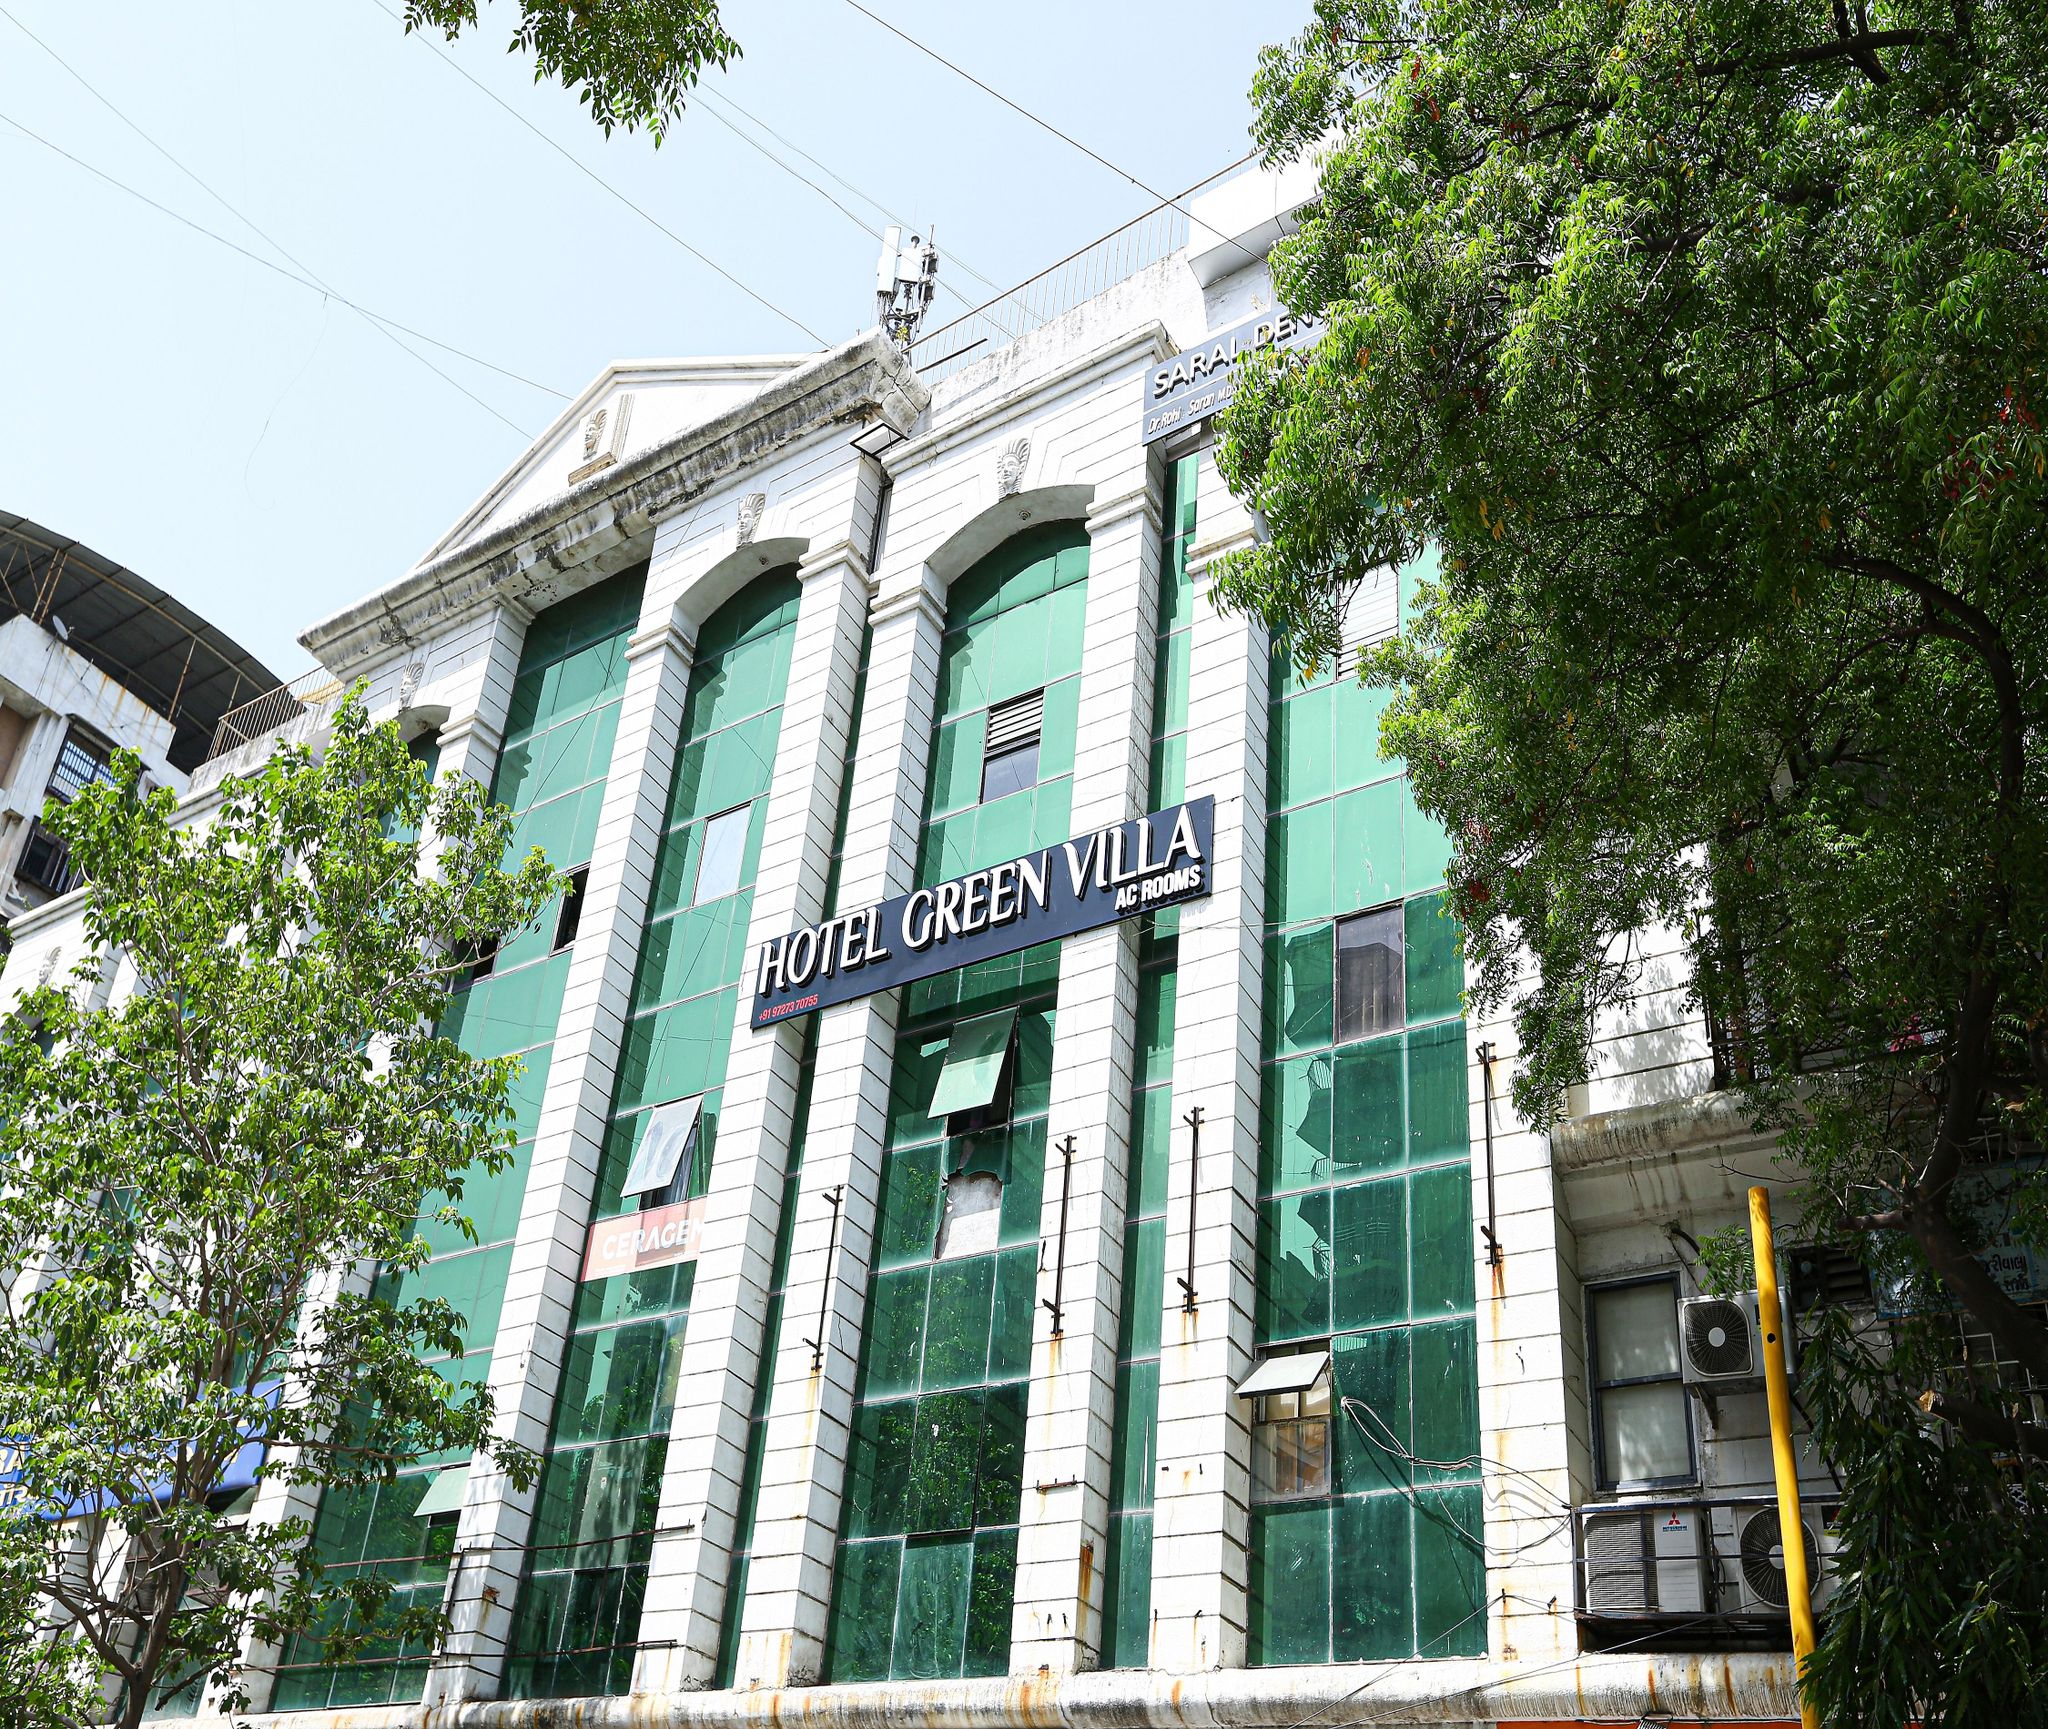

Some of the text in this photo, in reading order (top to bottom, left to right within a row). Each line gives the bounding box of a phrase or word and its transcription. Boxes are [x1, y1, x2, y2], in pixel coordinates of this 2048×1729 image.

[1152, 312, 1317, 398] SARAL DEN
[1187, 392, 1216, 416] Saran
[758, 804, 1202, 994] HOTEL GREEN VILLA
[1114, 864, 1201, 911] AC ROOMS
[758, 993, 819, 1022] +91 97273 70755
